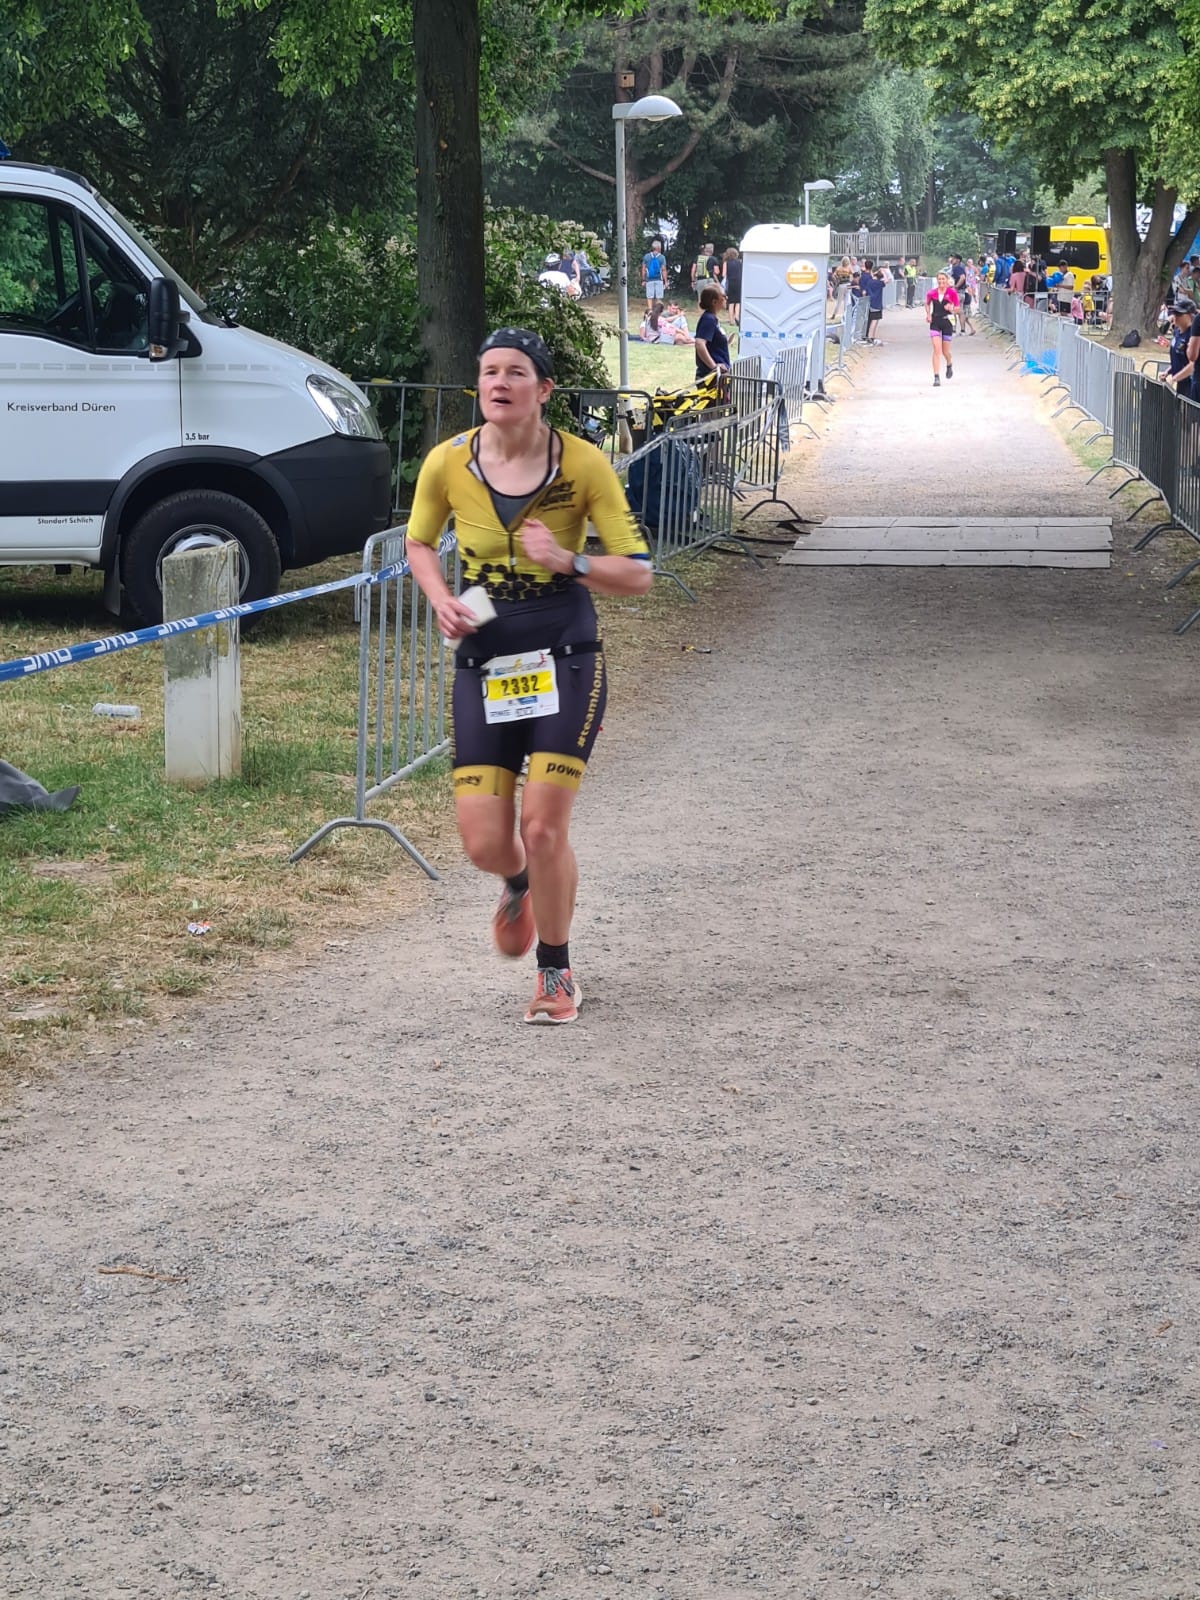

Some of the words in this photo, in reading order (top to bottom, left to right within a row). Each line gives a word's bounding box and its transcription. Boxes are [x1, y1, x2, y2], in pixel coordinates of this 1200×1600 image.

[7, 402, 78, 412] Kreisverband
[82, 402, 116, 412] Düren
[198, 432, 210, 441] bar
[501, 675, 540, 697] 2332
